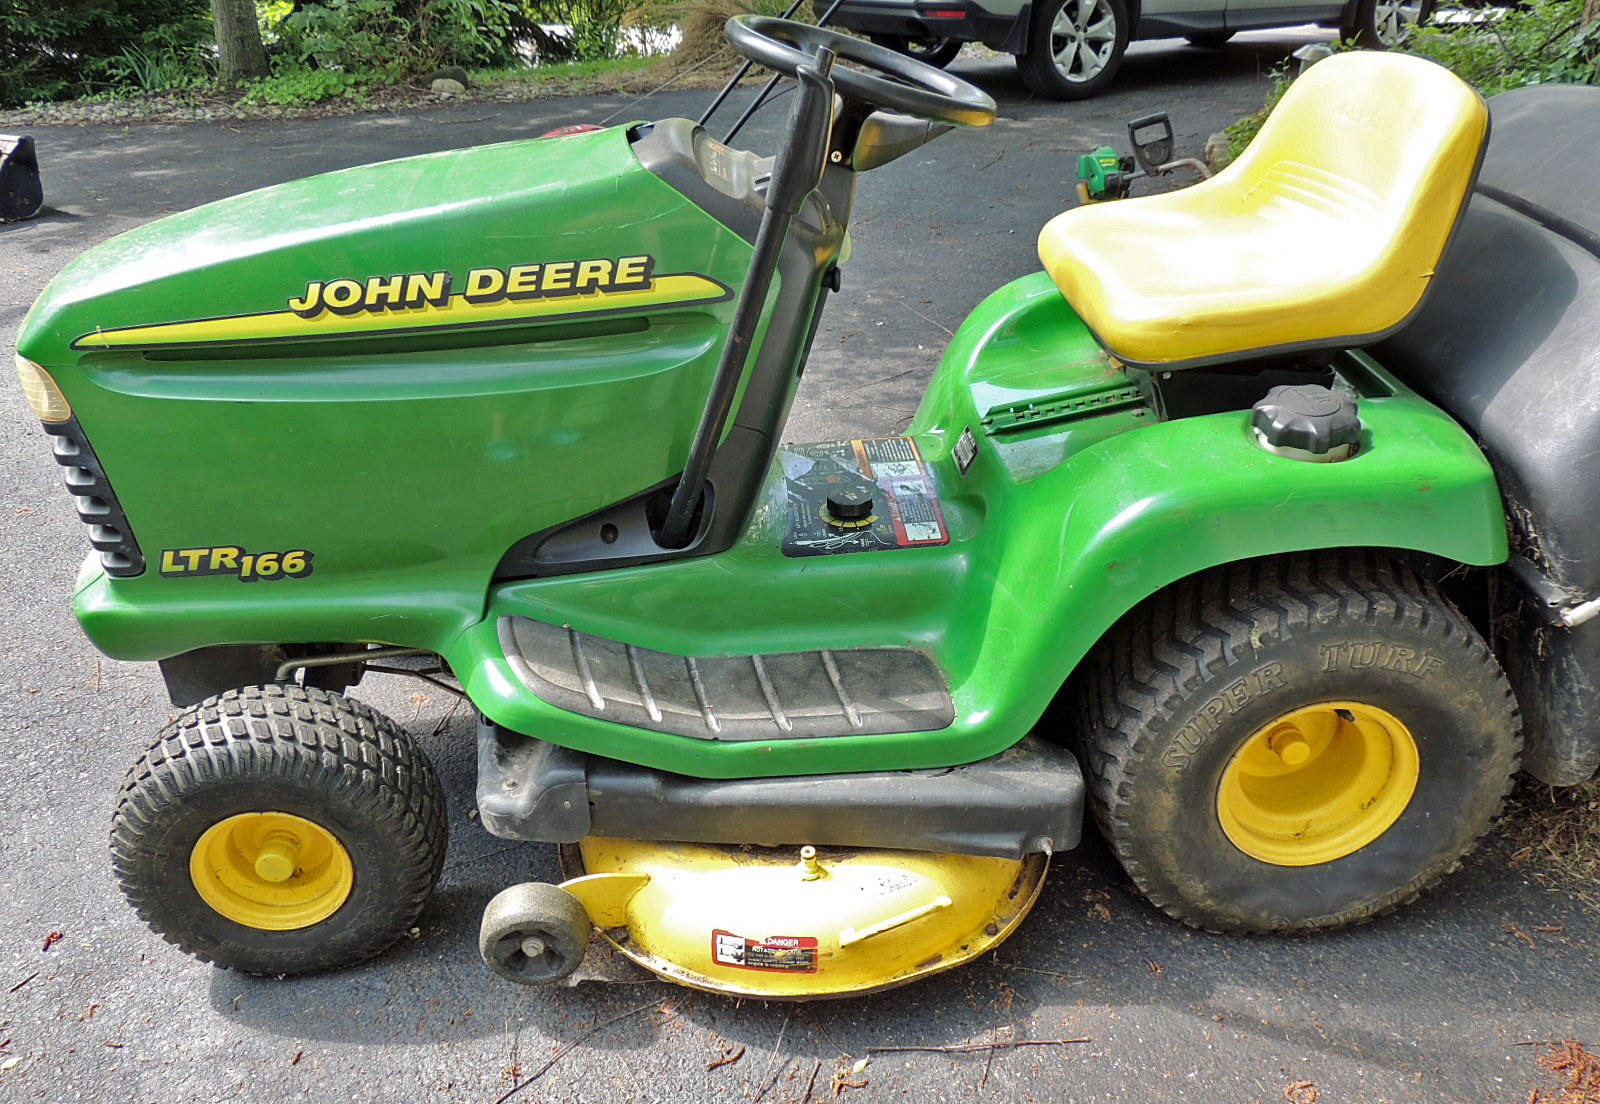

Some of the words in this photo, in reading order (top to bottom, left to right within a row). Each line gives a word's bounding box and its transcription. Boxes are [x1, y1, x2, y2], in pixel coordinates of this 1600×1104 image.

[288, 271, 451, 317] JOHN
[464, 255, 653, 302] DEERE
[160, 545, 312, 580] LTR166
[1161, 661, 1288, 774] SUPER
[1320, 641, 1447, 679] TURF
[767, 937, 799, 947] DANGER
